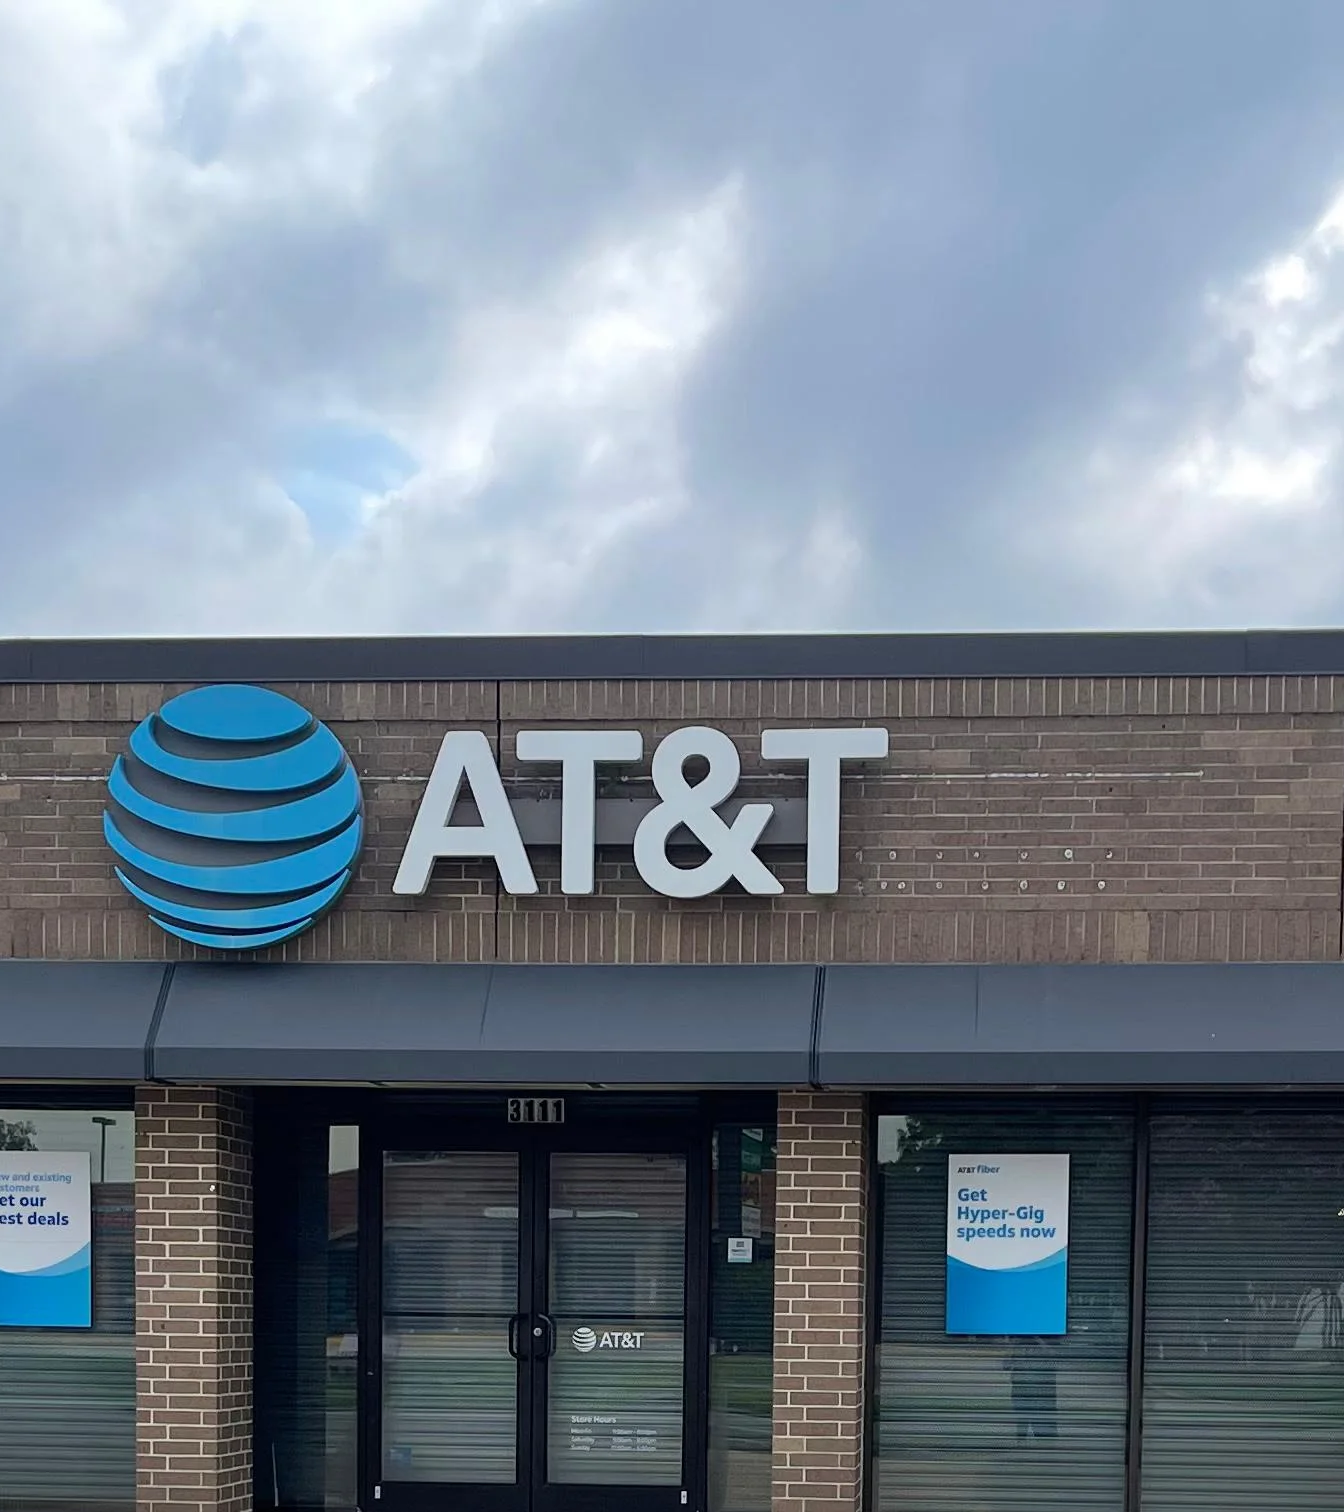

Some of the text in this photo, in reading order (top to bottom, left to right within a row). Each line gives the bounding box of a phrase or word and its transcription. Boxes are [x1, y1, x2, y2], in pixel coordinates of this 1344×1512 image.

[392, 725, 889, 898] AT&T
[509, 1099, 563, 1122] 3111
[12, 1172, 31, 1182] and
[33, 1173, 72, 1185] existing
[19, 1196, 47, 1207] our
[957, 1188, 988, 1202] Get
[27, 1211, 69, 1226] deals
[957, 1206, 1045, 1223] Hyper-Gig
[956, 1224, 1057, 1242] speeds now
[599, 1332, 645, 1349] AT&T
[571, 1415, 616, 1424] Store Hours
